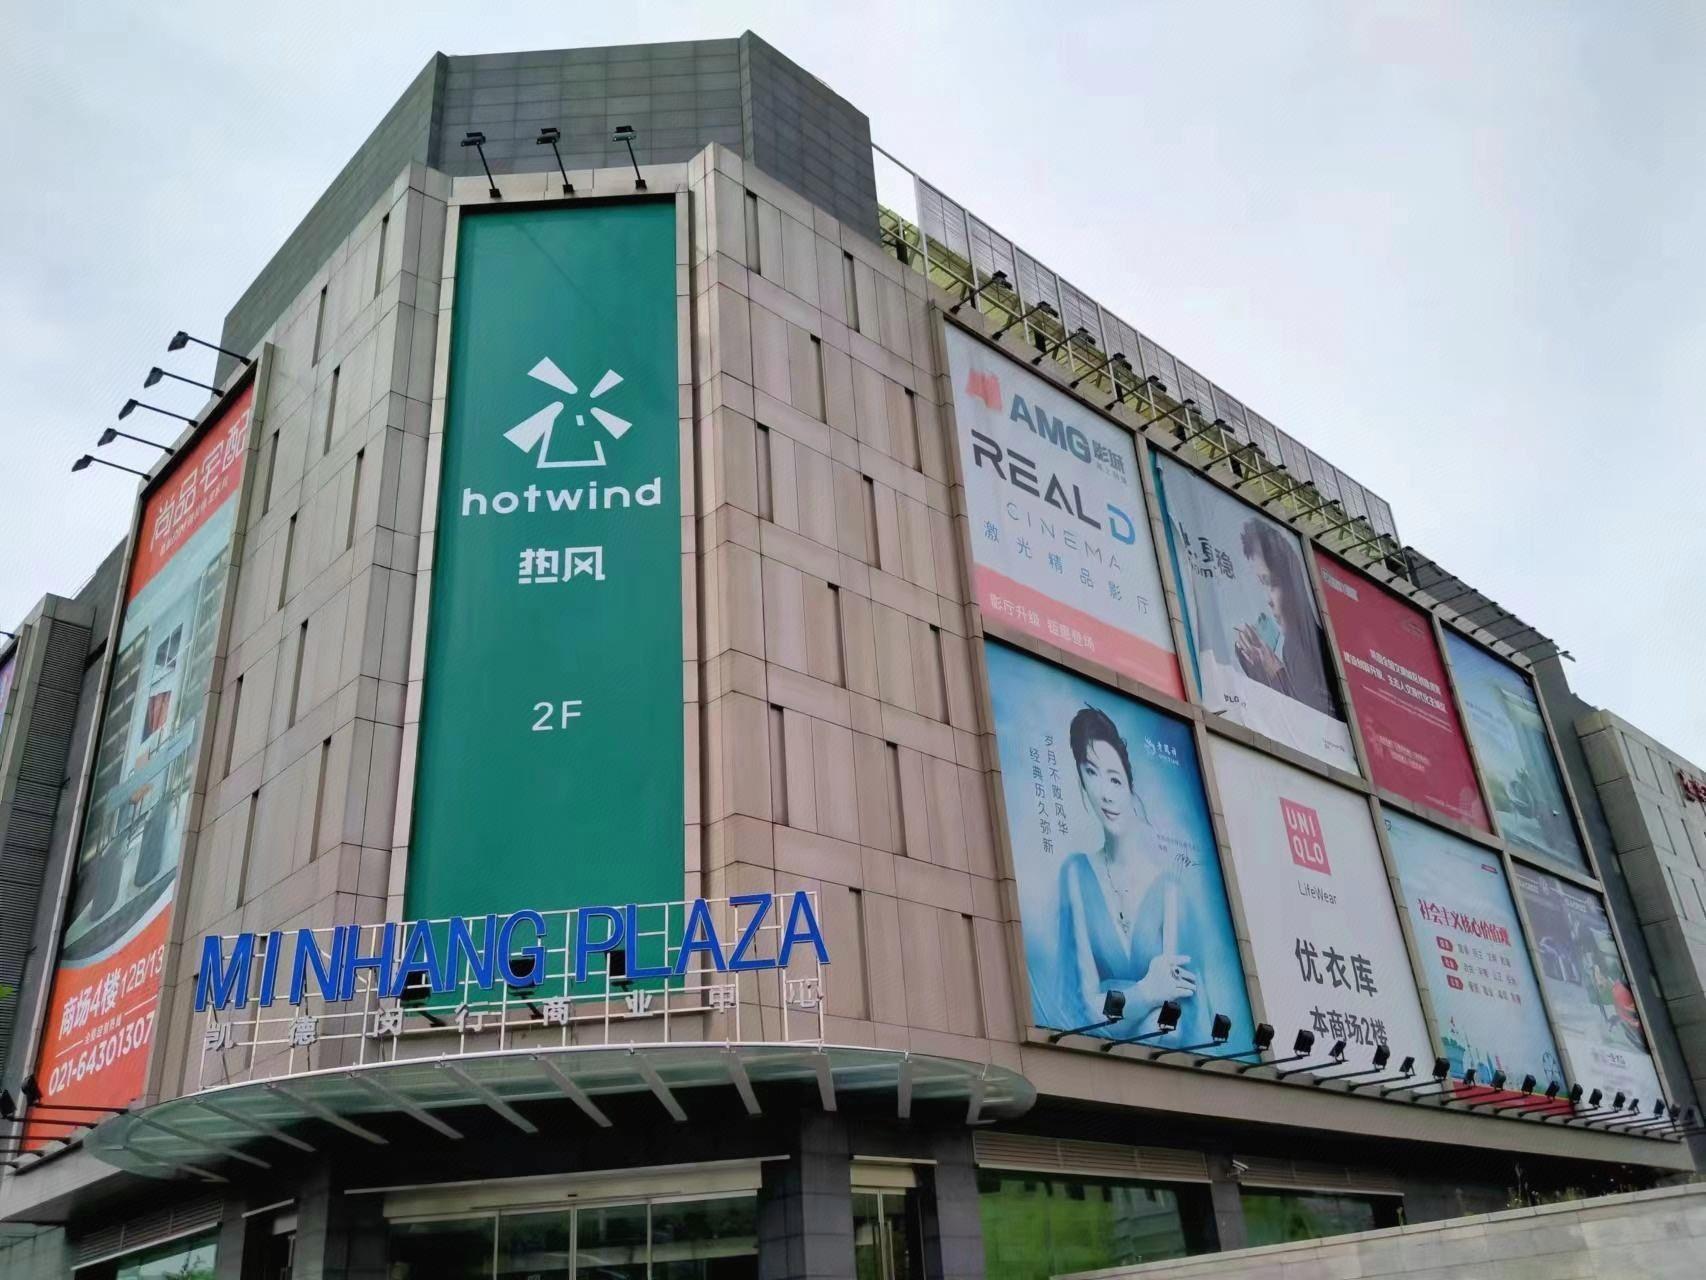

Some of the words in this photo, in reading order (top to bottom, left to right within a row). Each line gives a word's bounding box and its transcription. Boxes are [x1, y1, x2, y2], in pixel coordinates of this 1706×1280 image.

[1010, 394, 1092, 465] AMG
[150, 407, 251, 553] 尚品宅配
[462, 477, 662, 516] hotwind
[971, 429, 1101, 530] REAL
[1107, 503, 1136, 545] D
[518, 545, 606, 584] 热风
[984, 520, 1149, 615] 激光精品影厅
[1007, 502, 1121, 570] CINEMA
[531, 700, 583, 731] 2F
[1029, 746, 1054, 855] 经典历久弥新
[1044, 735, 1069, 835] 岁月不败风华
[1286, 807, 1316, 838] UNI
[1293, 835, 1324, 865] QLO
[1297, 880, 1337, 905] LifeWear
[194, 908, 546, 1013] MINHANG
[575, 890, 831, 983] PLAZA
[1295, 937, 1378, 998] 优衣库
[59, 967, 122, 1041] 商场4楼
[1309, 1005, 1388, 1047] 本商场2楼
[49, 1010, 156, 1097] 021-64301307
